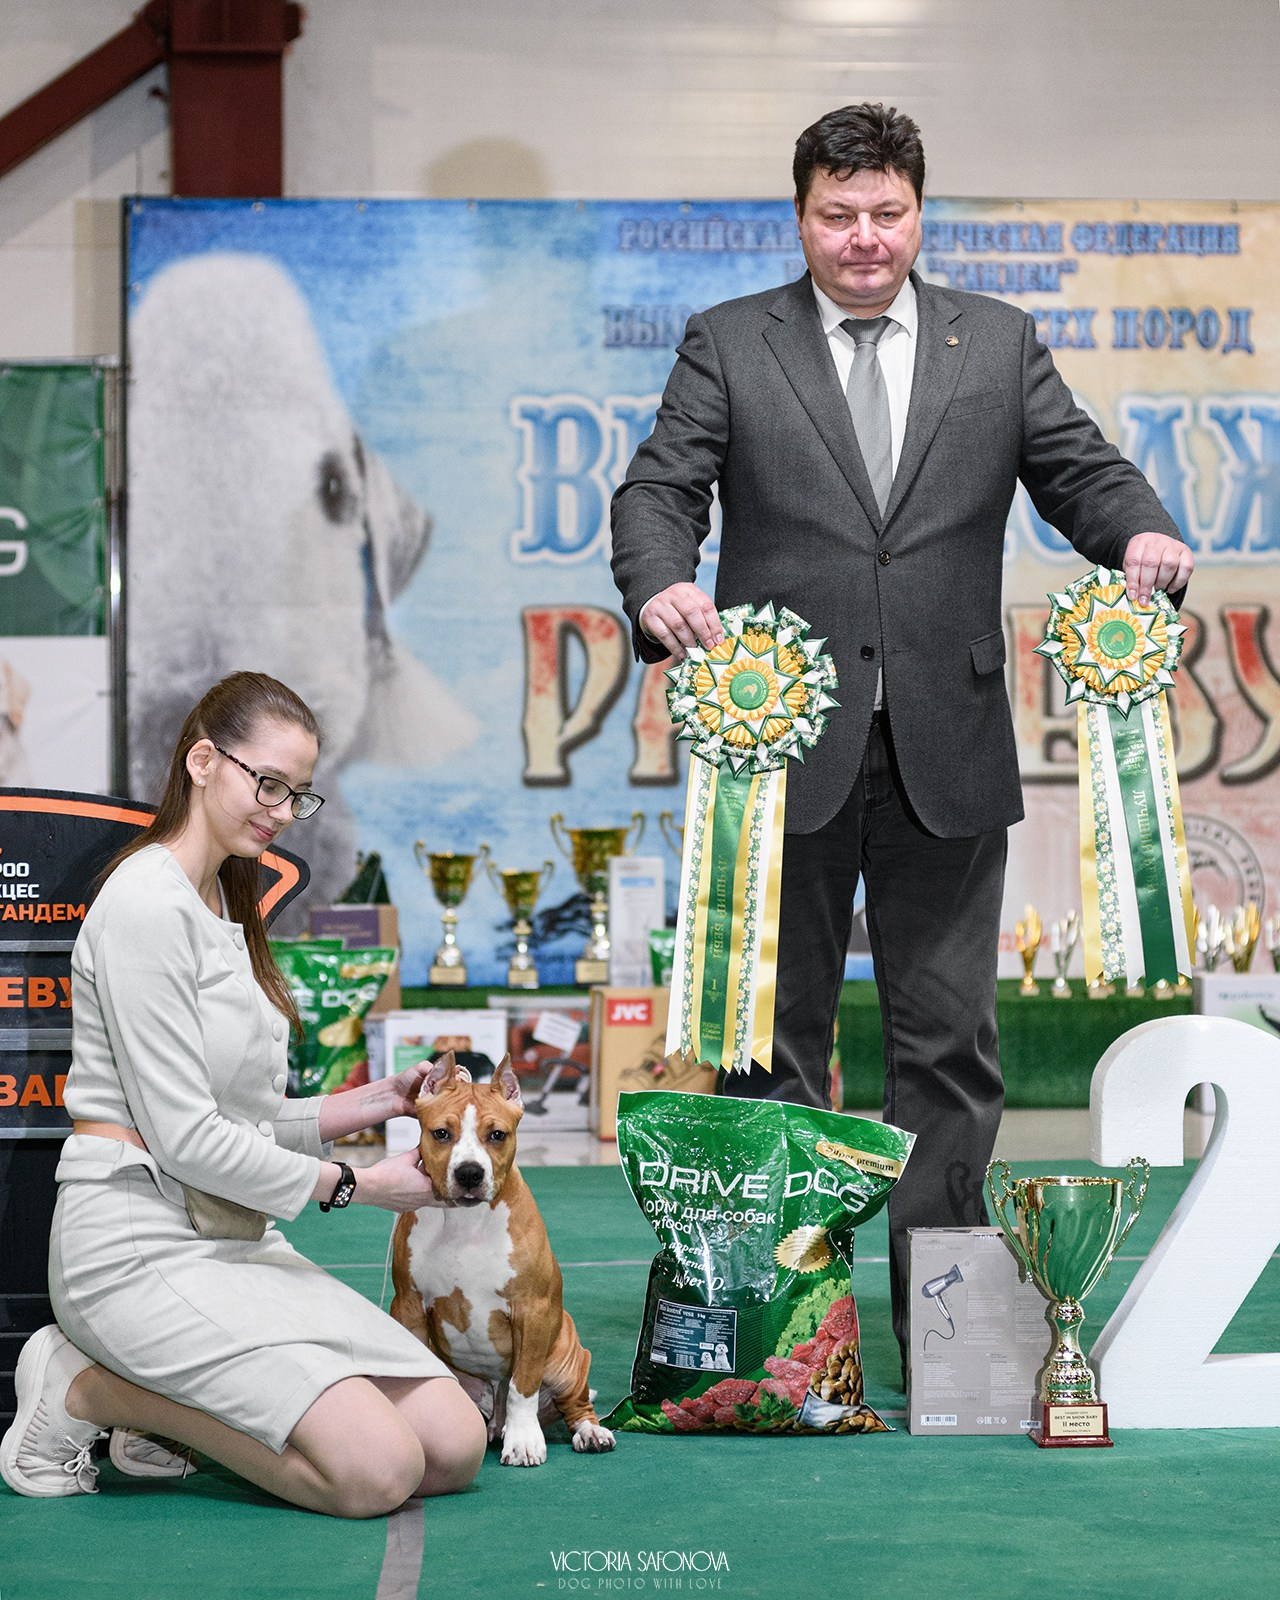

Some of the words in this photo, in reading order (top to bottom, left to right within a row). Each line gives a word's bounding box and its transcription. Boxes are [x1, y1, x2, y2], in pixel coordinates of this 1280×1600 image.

[921, 221, 1064, 252] ГИЧЕСКАЯ
[1070, 221, 1241, 256] ФЕДЕРАЦИИ
[1031, 306, 1098, 350] СЕХ
[1111, 306, 1256, 355] ПОРОД
[0, 862, 30, 878] ОО
[0, 884, 40, 900] ЦЕС
[611, 1003, 648, 1021] JVC
[856, 1157, 895, 1172] premium
[639, 1161, 770, 1199] DRIVE
[784, 1167, 870, 1213] DOG
[645, 1198, 677, 1216] орм
[681, 1206, 717, 1222] для
[722, 1207, 777, 1225] собак
[1090, 1014, 1280, 1429] 2
[661, 1215, 693, 1235] food
